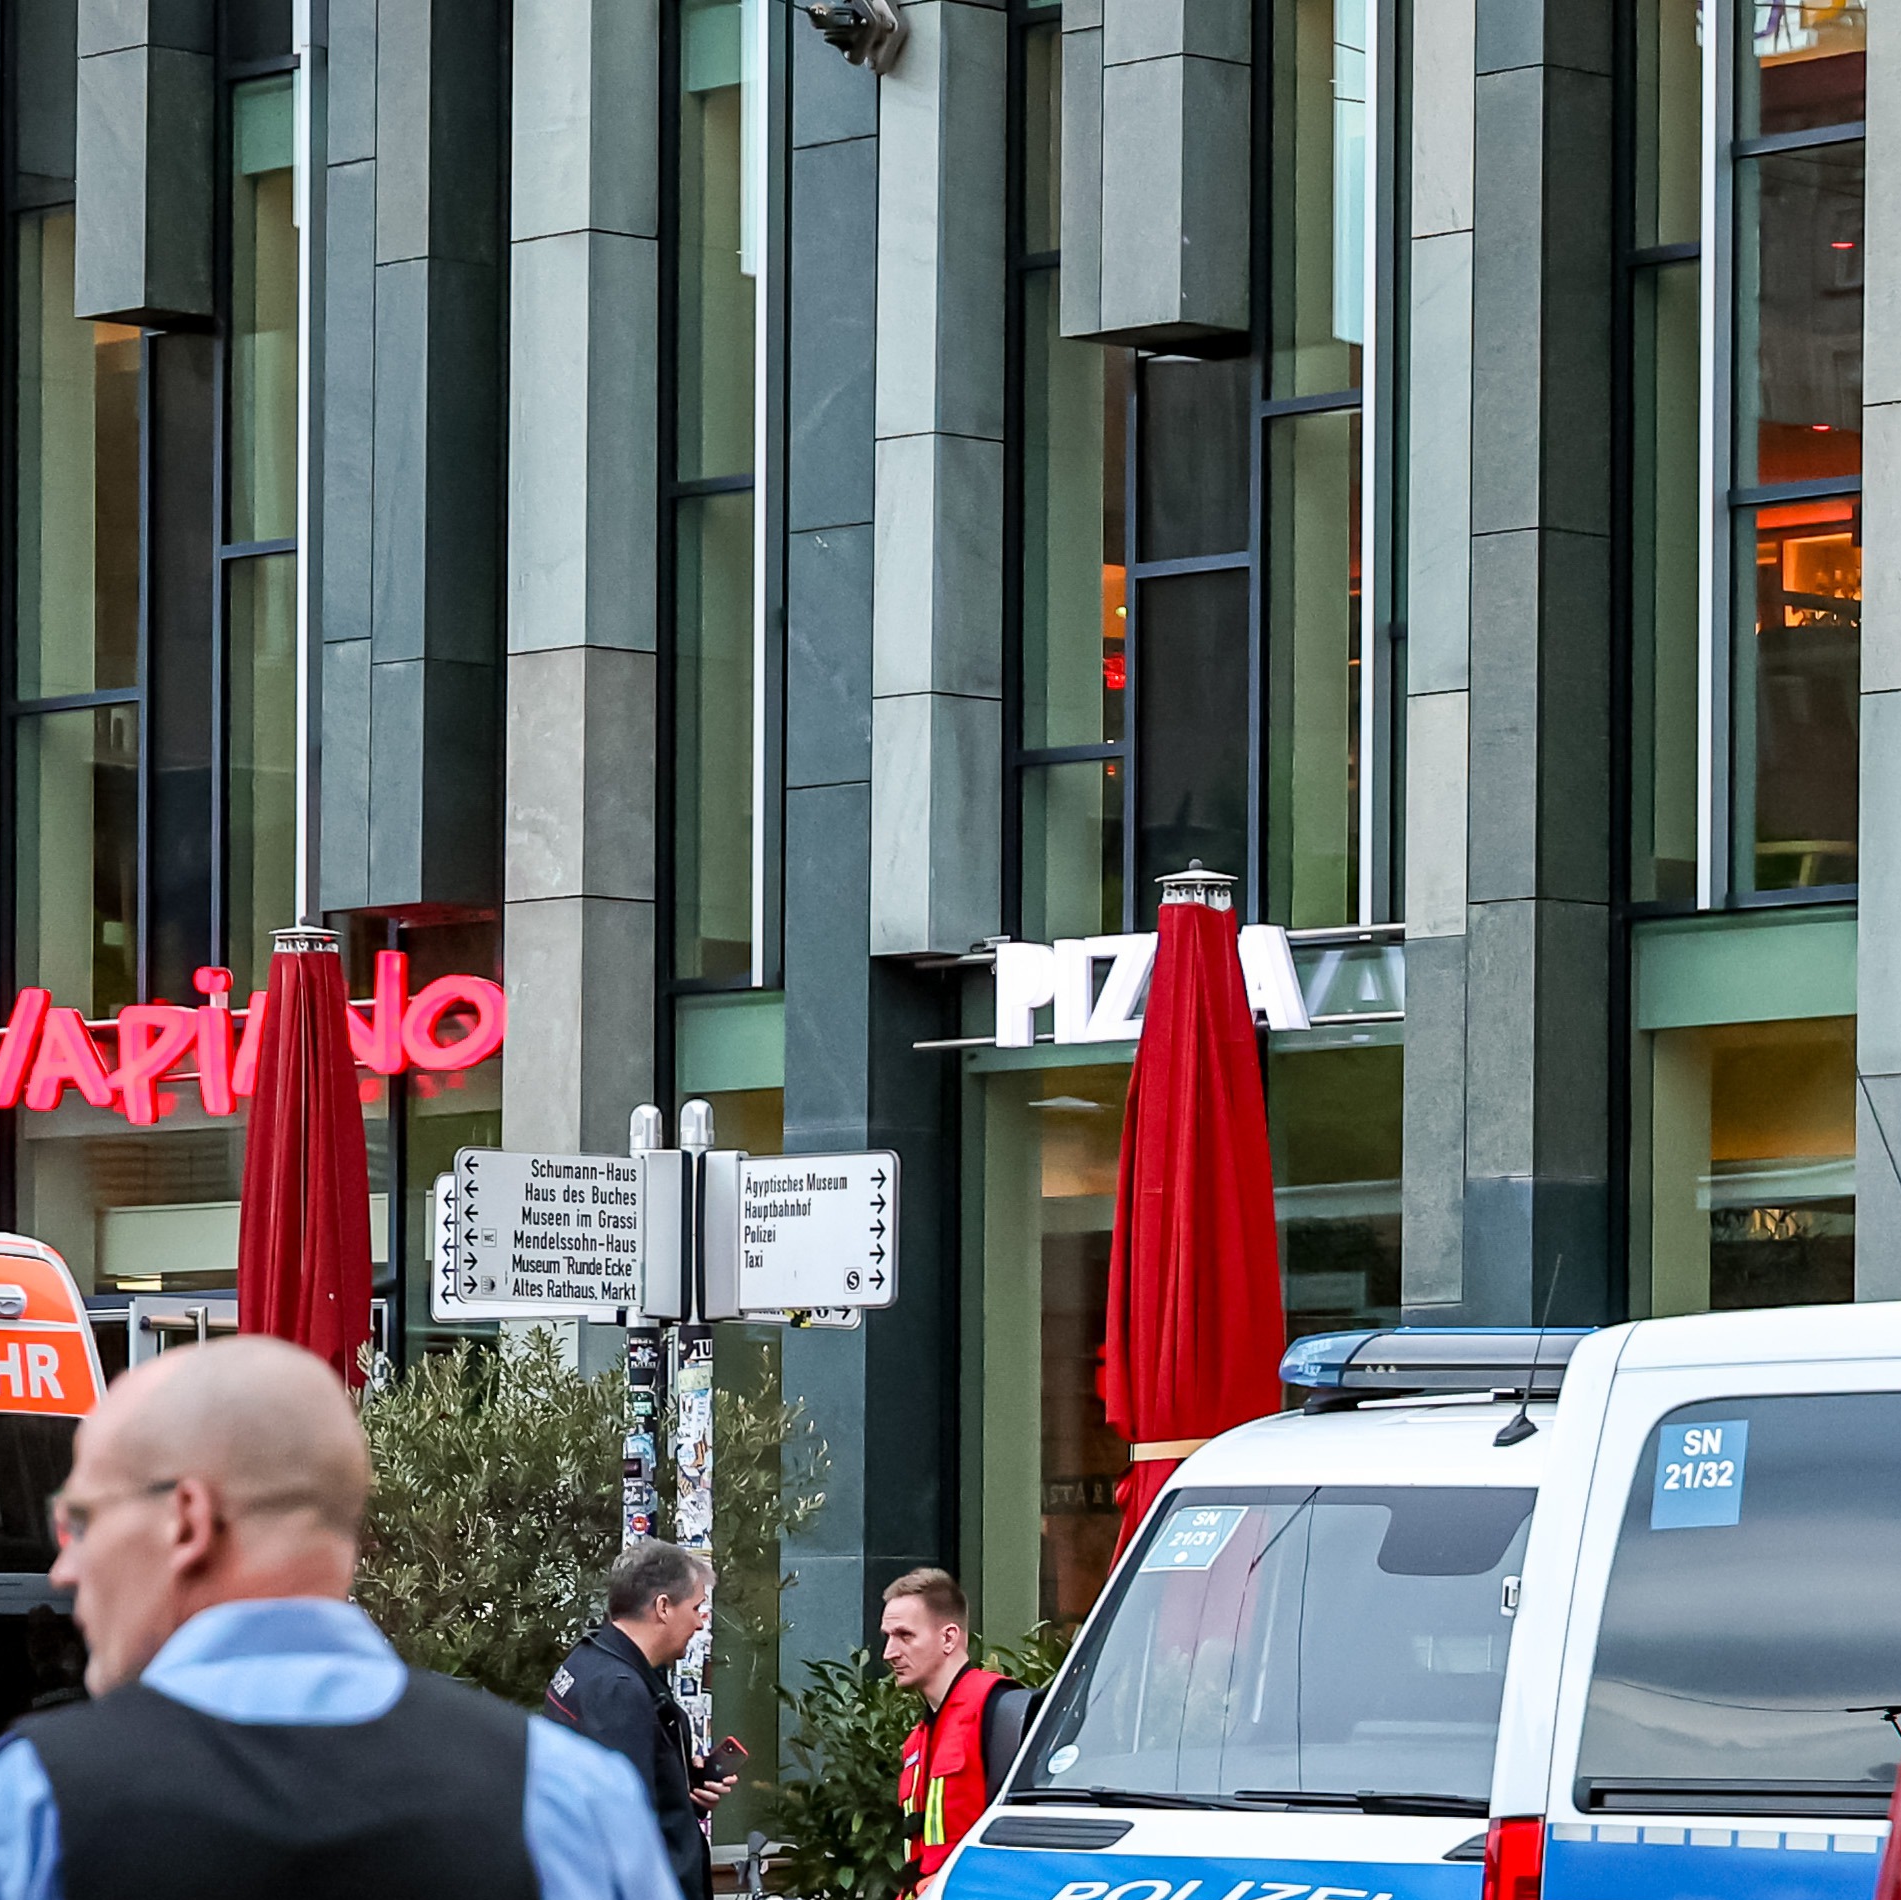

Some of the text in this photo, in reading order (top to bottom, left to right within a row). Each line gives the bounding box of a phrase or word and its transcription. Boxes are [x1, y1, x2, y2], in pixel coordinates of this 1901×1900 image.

[996, 924, 1311, 1048] PIZA
[531, 1158, 637, 1182] Schumann-Haus
[525, 1182, 637, 1206] Haus des Buches
[745, 1172, 848, 1198] Ägyptisches Museum
[522, 1206, 637, 1230] Museen im Grassi
[744, 1197, 811, 1222] Hauptbahnhof
[513, 1230, 637, 1253] Mendelssohn-Haus
[744, 1224, 776, 1244] Polizei
[512, 1253, 560, 1274] Museum
[744, 1250, 763, 1268] Taxi
[512, 1278, 636, 1300] Altes Rathaus, Markt
[1683, 1427, 1722, 1457] SN
[1663, 1460, 1735, 1490] 21/32
[1192, 1511, 1222, 1527] SN
[1168, 1530, 1217, 1547] 21/31
